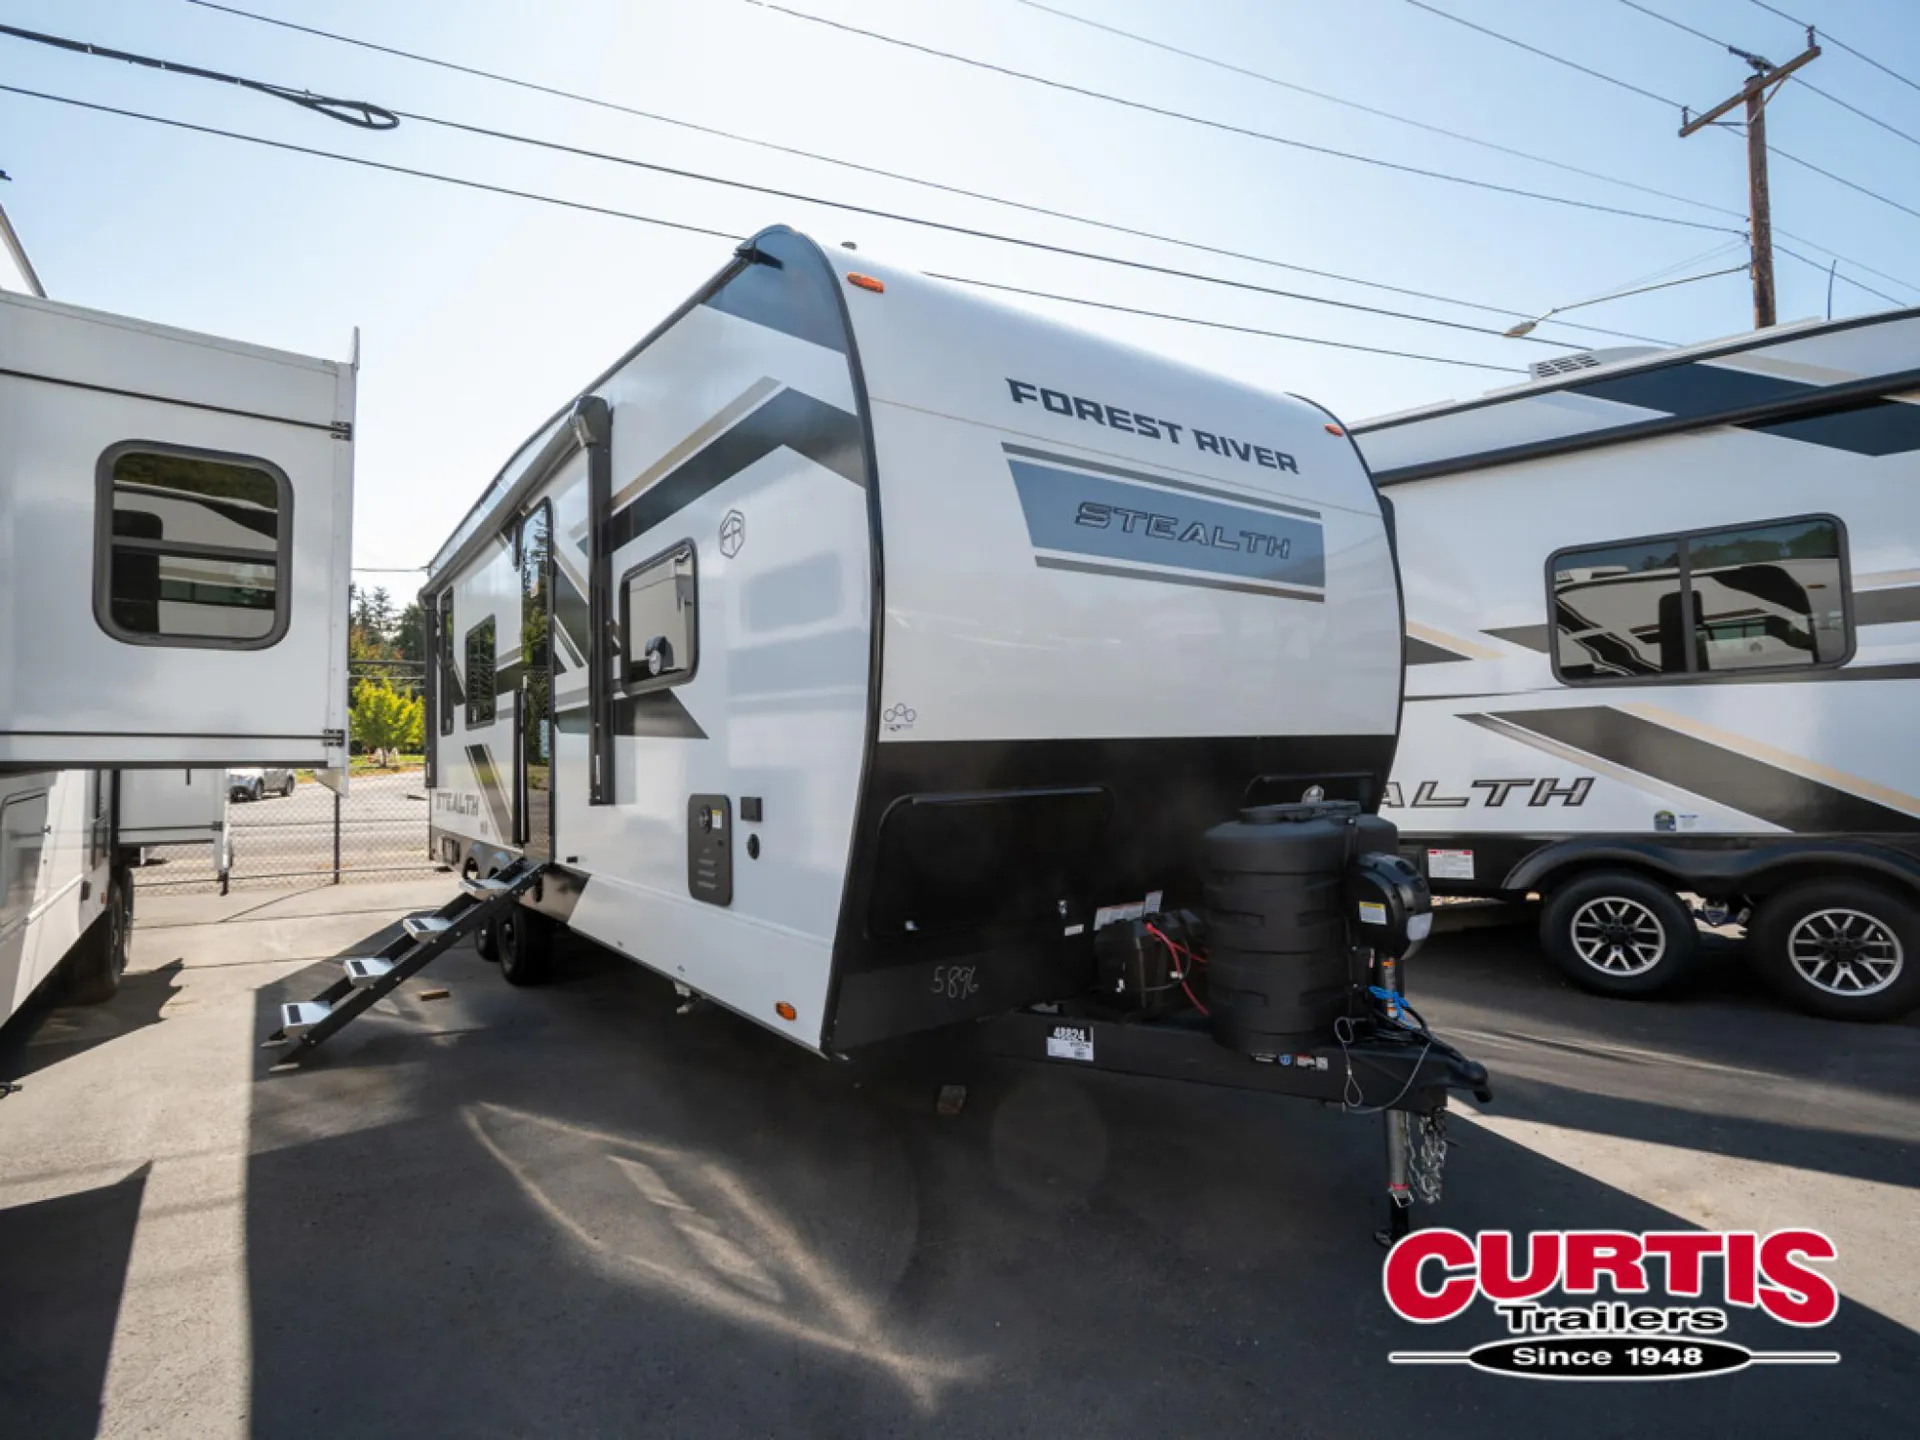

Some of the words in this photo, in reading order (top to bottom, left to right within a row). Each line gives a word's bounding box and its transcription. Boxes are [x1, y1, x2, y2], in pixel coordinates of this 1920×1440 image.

[1005, 377, 1183, 445] FOREST
[1192, 428, 1300, 475] RIVER
[1073, 501, 1291, 560] STEALTH
[1380, 777, 1596, 808] ALTH
